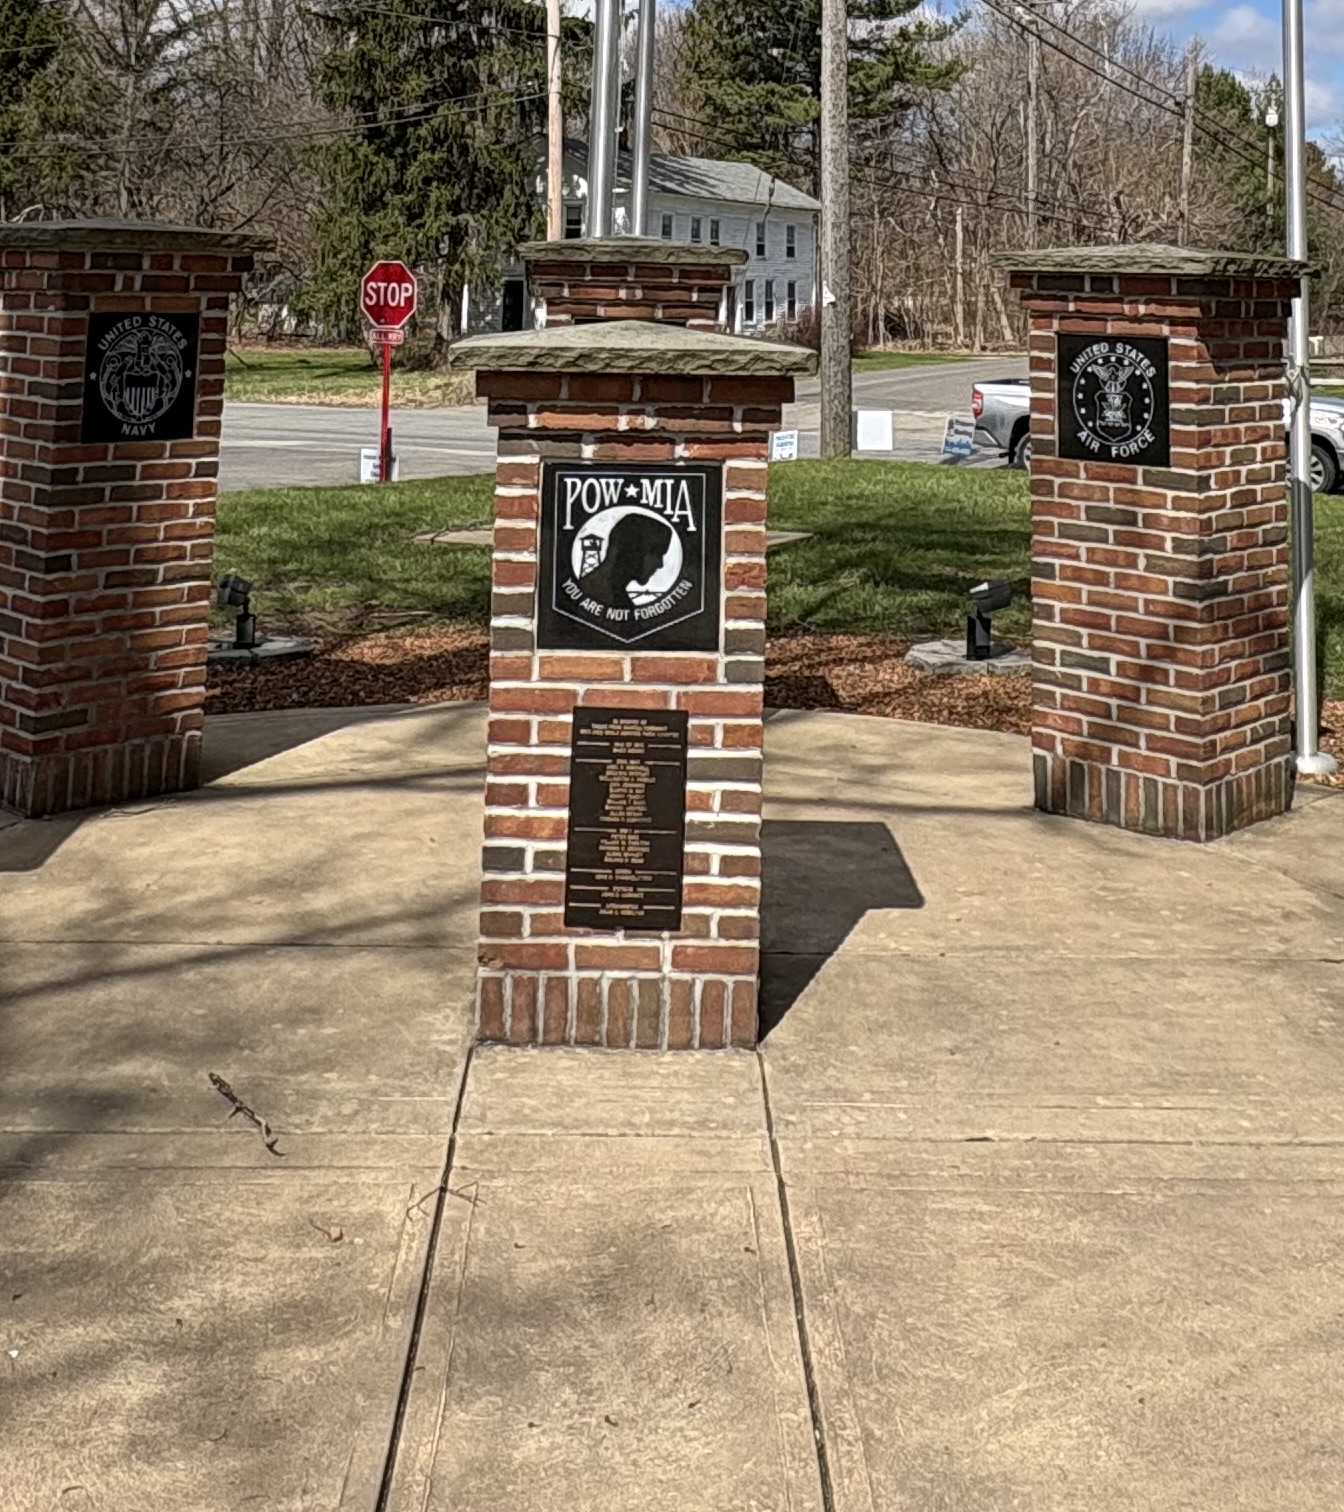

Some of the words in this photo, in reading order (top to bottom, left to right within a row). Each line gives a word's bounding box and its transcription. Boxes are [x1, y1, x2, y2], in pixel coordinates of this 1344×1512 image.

[365, 282, 413, 307] STOP
[97, 316, 142, 351] UNITED
[148, 315, 188, 350] STATES
[1069, 342, 1109, 375] UNITED
[1115, 342, 1157, 378] STATES
[121, 422, 156, 436] NAVY
[1076, 429, 1100, 454] AIR
[1111, 428, 1157, 458] FORCE
[563, 477, 624, 530] POW
[640, 478, 697, 532] MIA
[561, 577, 584, 600] YOU
[579, 597, 604, 616] ARE
[606, 607, 630, 621] NOT
[633, 579, 694, 621] FORGOTTEN
